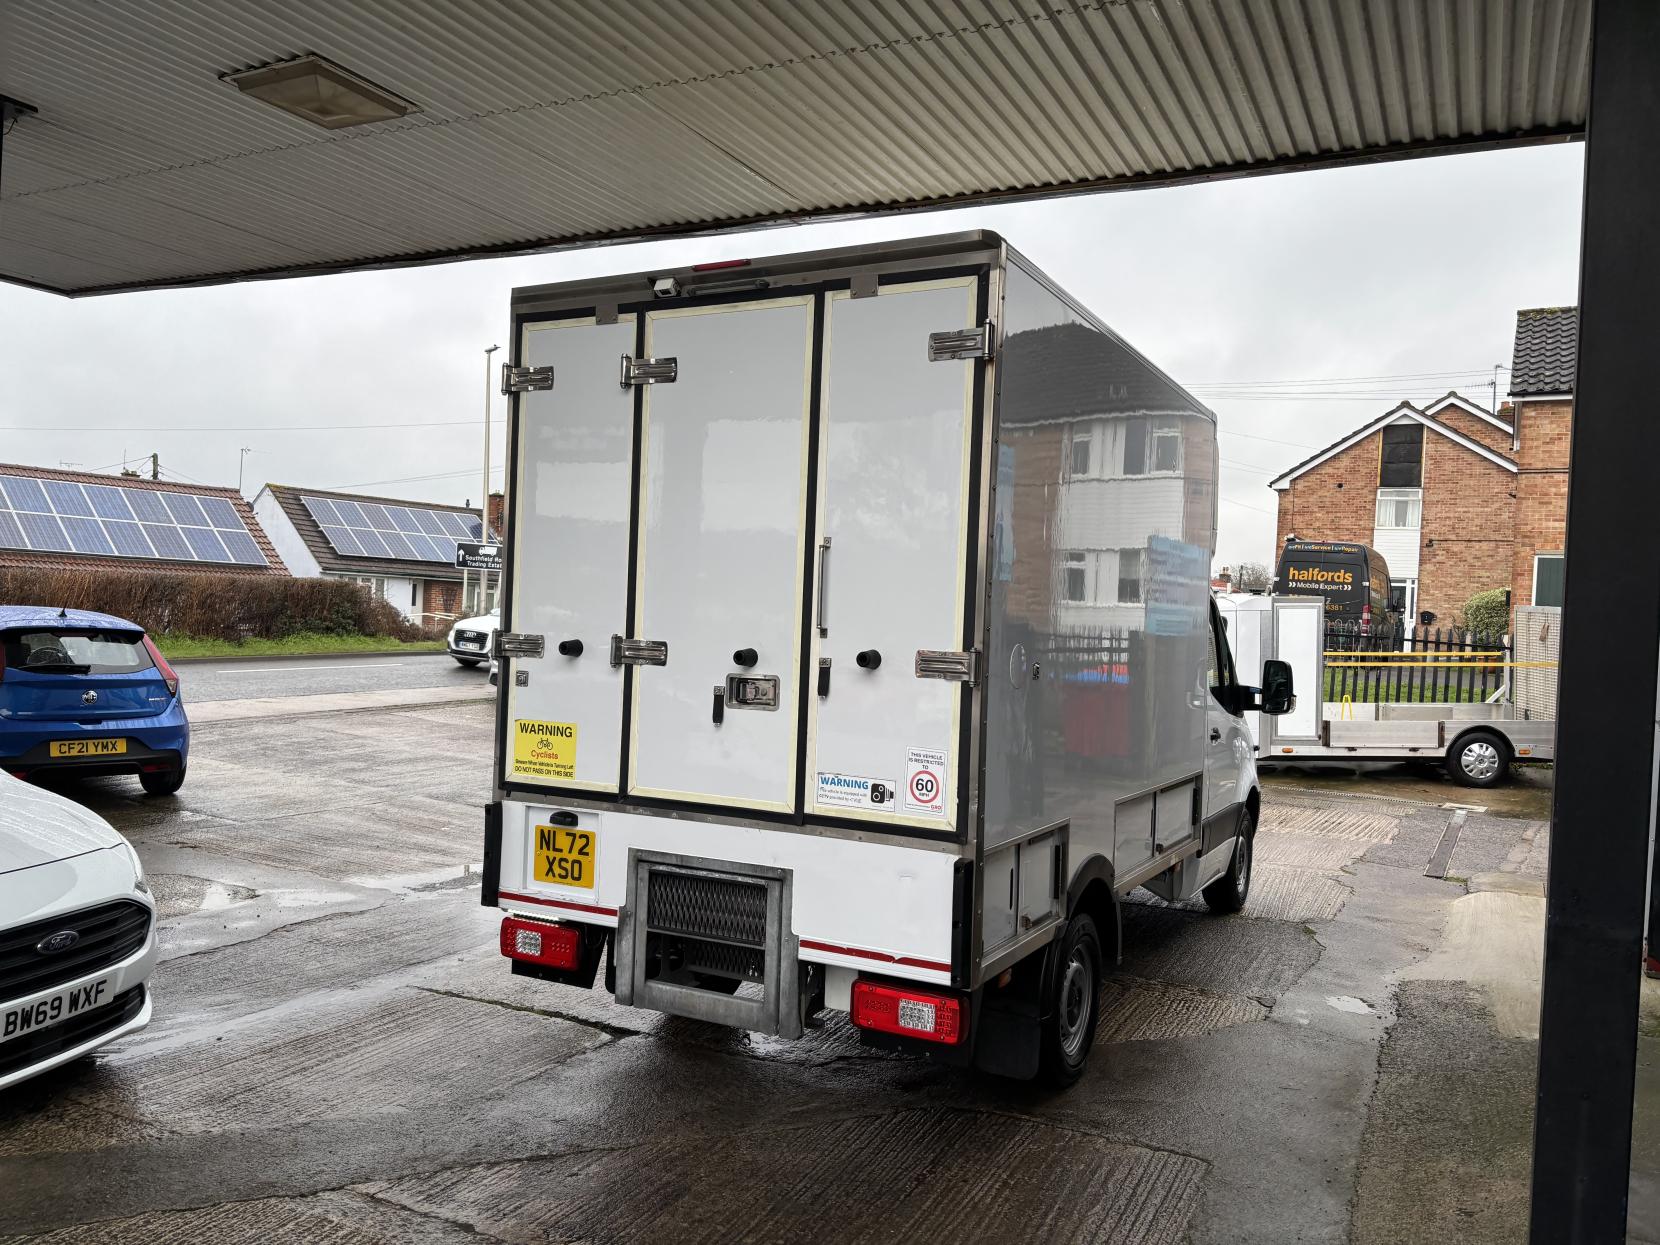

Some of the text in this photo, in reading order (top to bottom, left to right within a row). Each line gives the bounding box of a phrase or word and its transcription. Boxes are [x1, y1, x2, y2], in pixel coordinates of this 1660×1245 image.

[465, 554, 493, 562] Southfield
[1288, 567, 1353, 583] halfords
[1320, 583, 1343, 591] Expert
[519, 722, 573, 738] WARNING
[58, 740, 118, 754] CF21 YMX
[531, 749, 559, 760] Cyclists
[914, 758, 944, 766] RESTRICTED
[922, 753, 943, 761] VEHICLE
[532, 767, 544, 775] PASS
[552, 769, 562, 777] THIS
[563, 770, 574, 778] SIDE
[820, 775, 869, 790] WARNING
[915, 778, 934, 793] 60
[539, 828, 590, 857] NL72
[545, 855, 583, 881] XSO
[51, 934, 72, 949] Ford
[3, 979, 107, 1037] BW69 WXF
